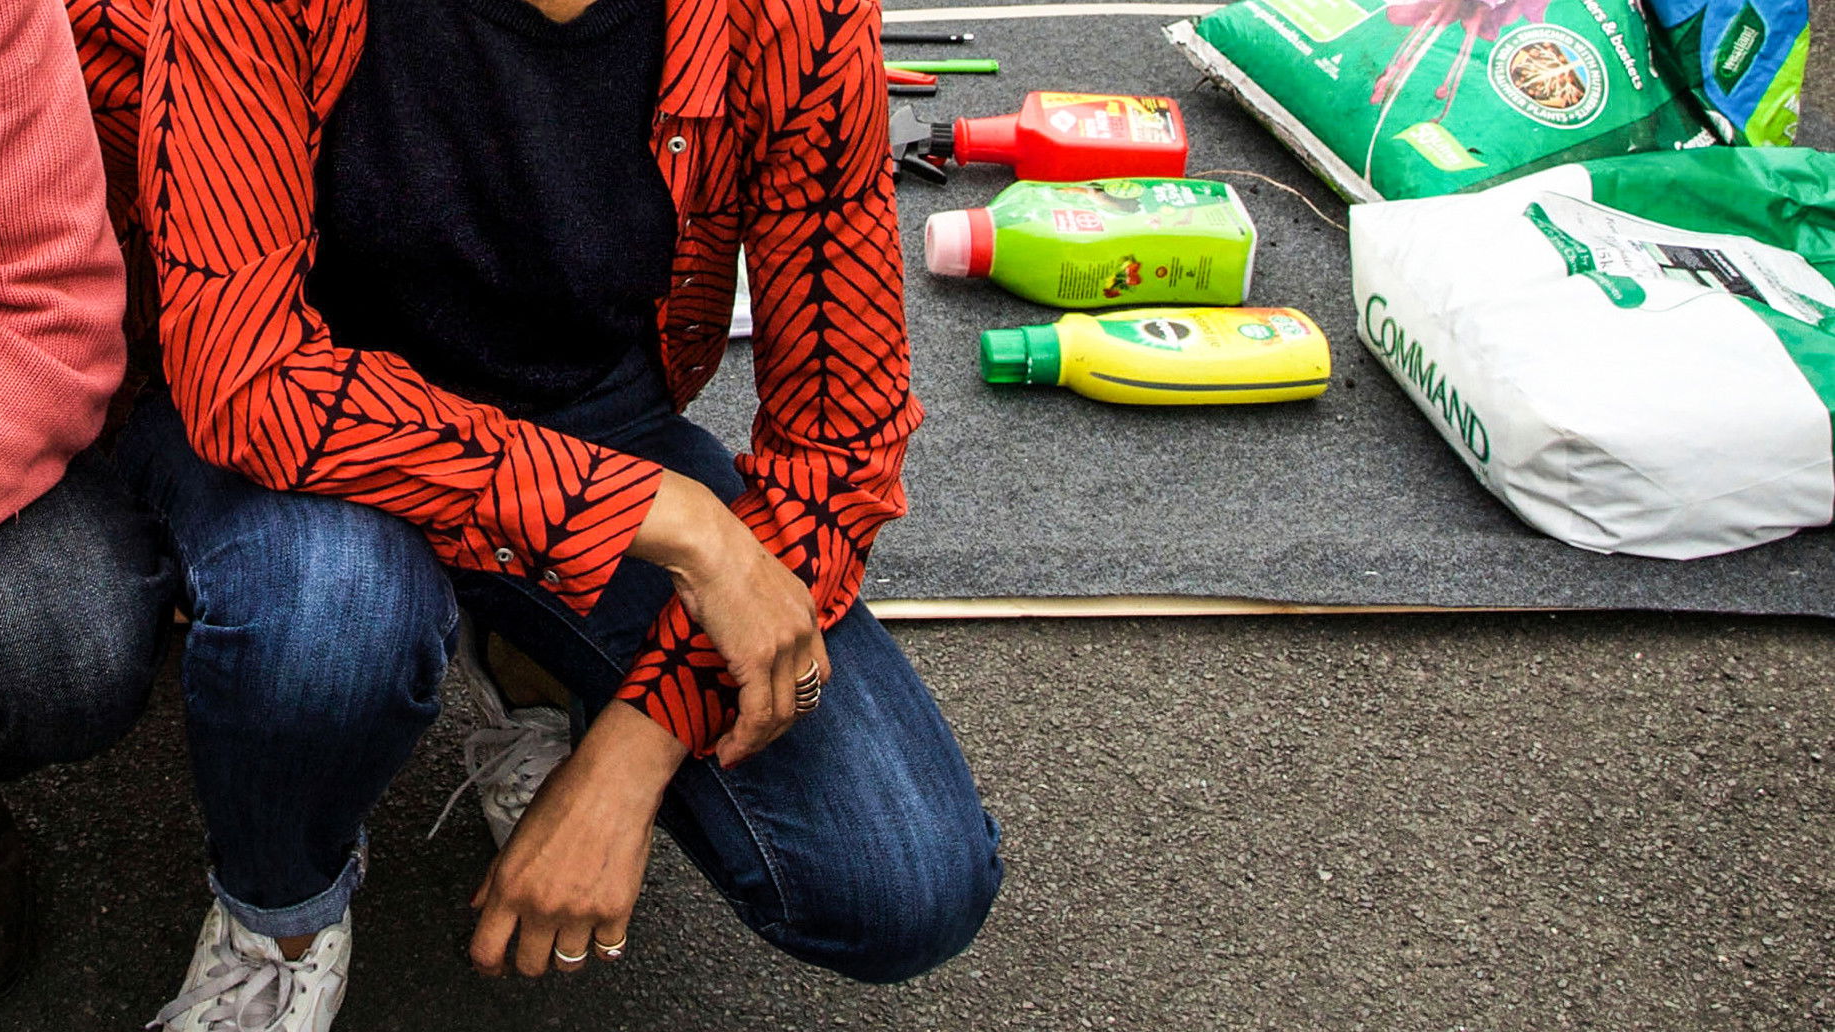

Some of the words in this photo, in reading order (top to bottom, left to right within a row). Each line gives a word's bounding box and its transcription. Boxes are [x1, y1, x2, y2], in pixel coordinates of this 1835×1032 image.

[1601, 20, 1618, 37] &
[1574, 40, 1597, 68] WITH
[1609, 28, 1644, 91] baskets
[1528, 103, 1569, 122] PLANTS
[1365, 293, 1490, 464] COMMAND
